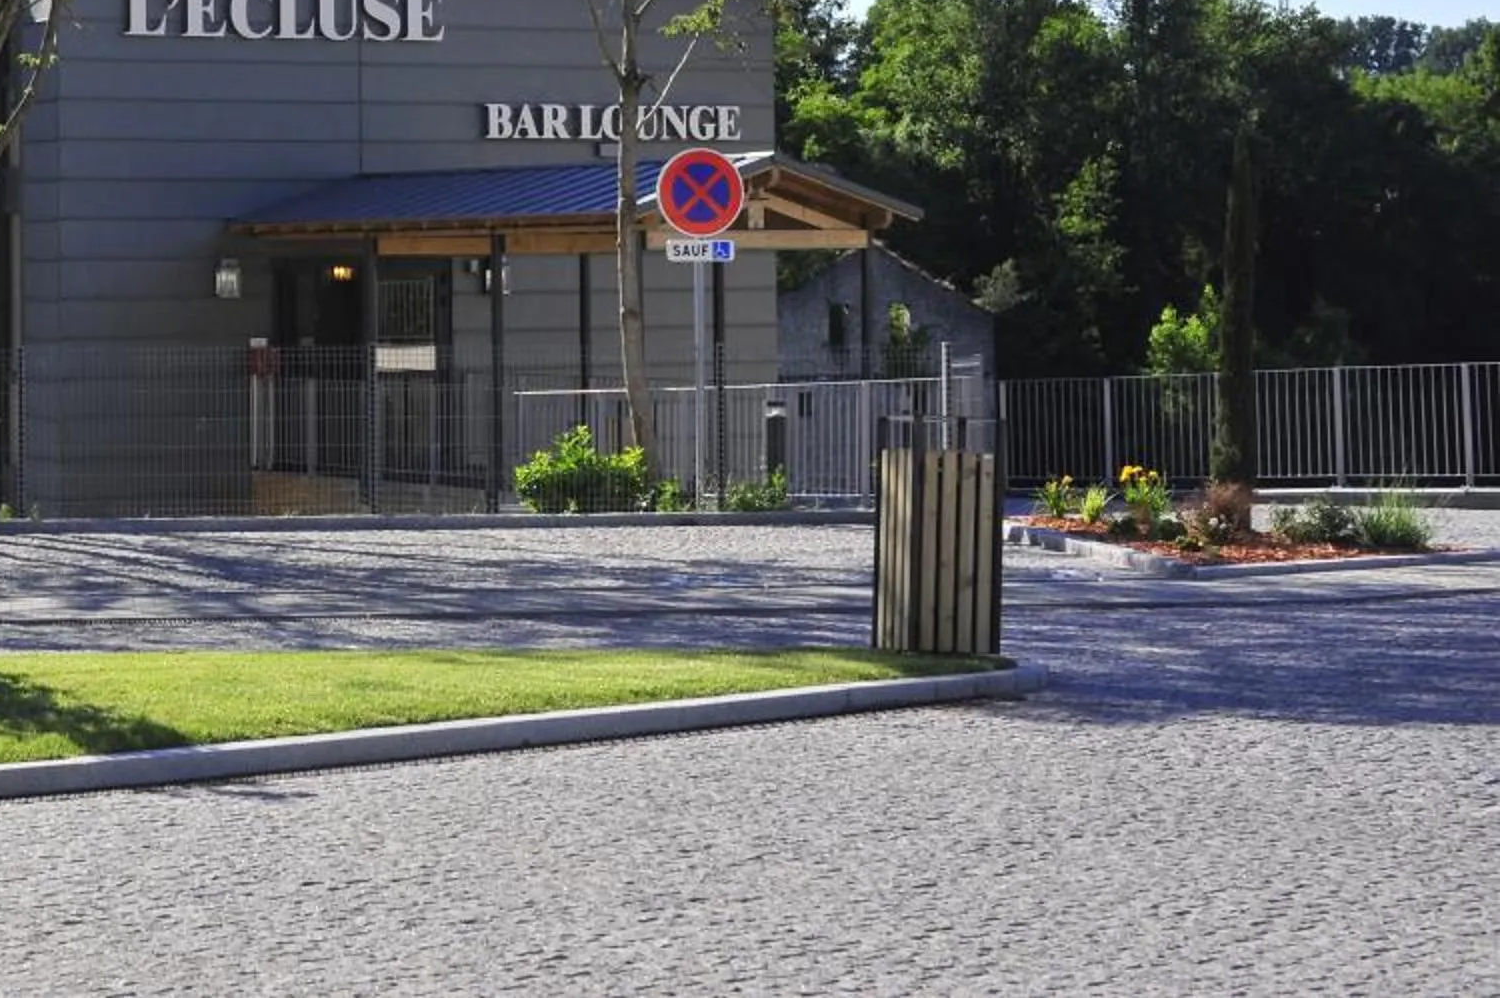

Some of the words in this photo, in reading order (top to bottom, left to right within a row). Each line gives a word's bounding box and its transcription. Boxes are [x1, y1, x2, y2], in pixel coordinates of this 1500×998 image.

[484, 103, 571, 140] BAR
[579, 104, 741, 141] LOUNGE
[673, 244, 709, 257] SAUF
